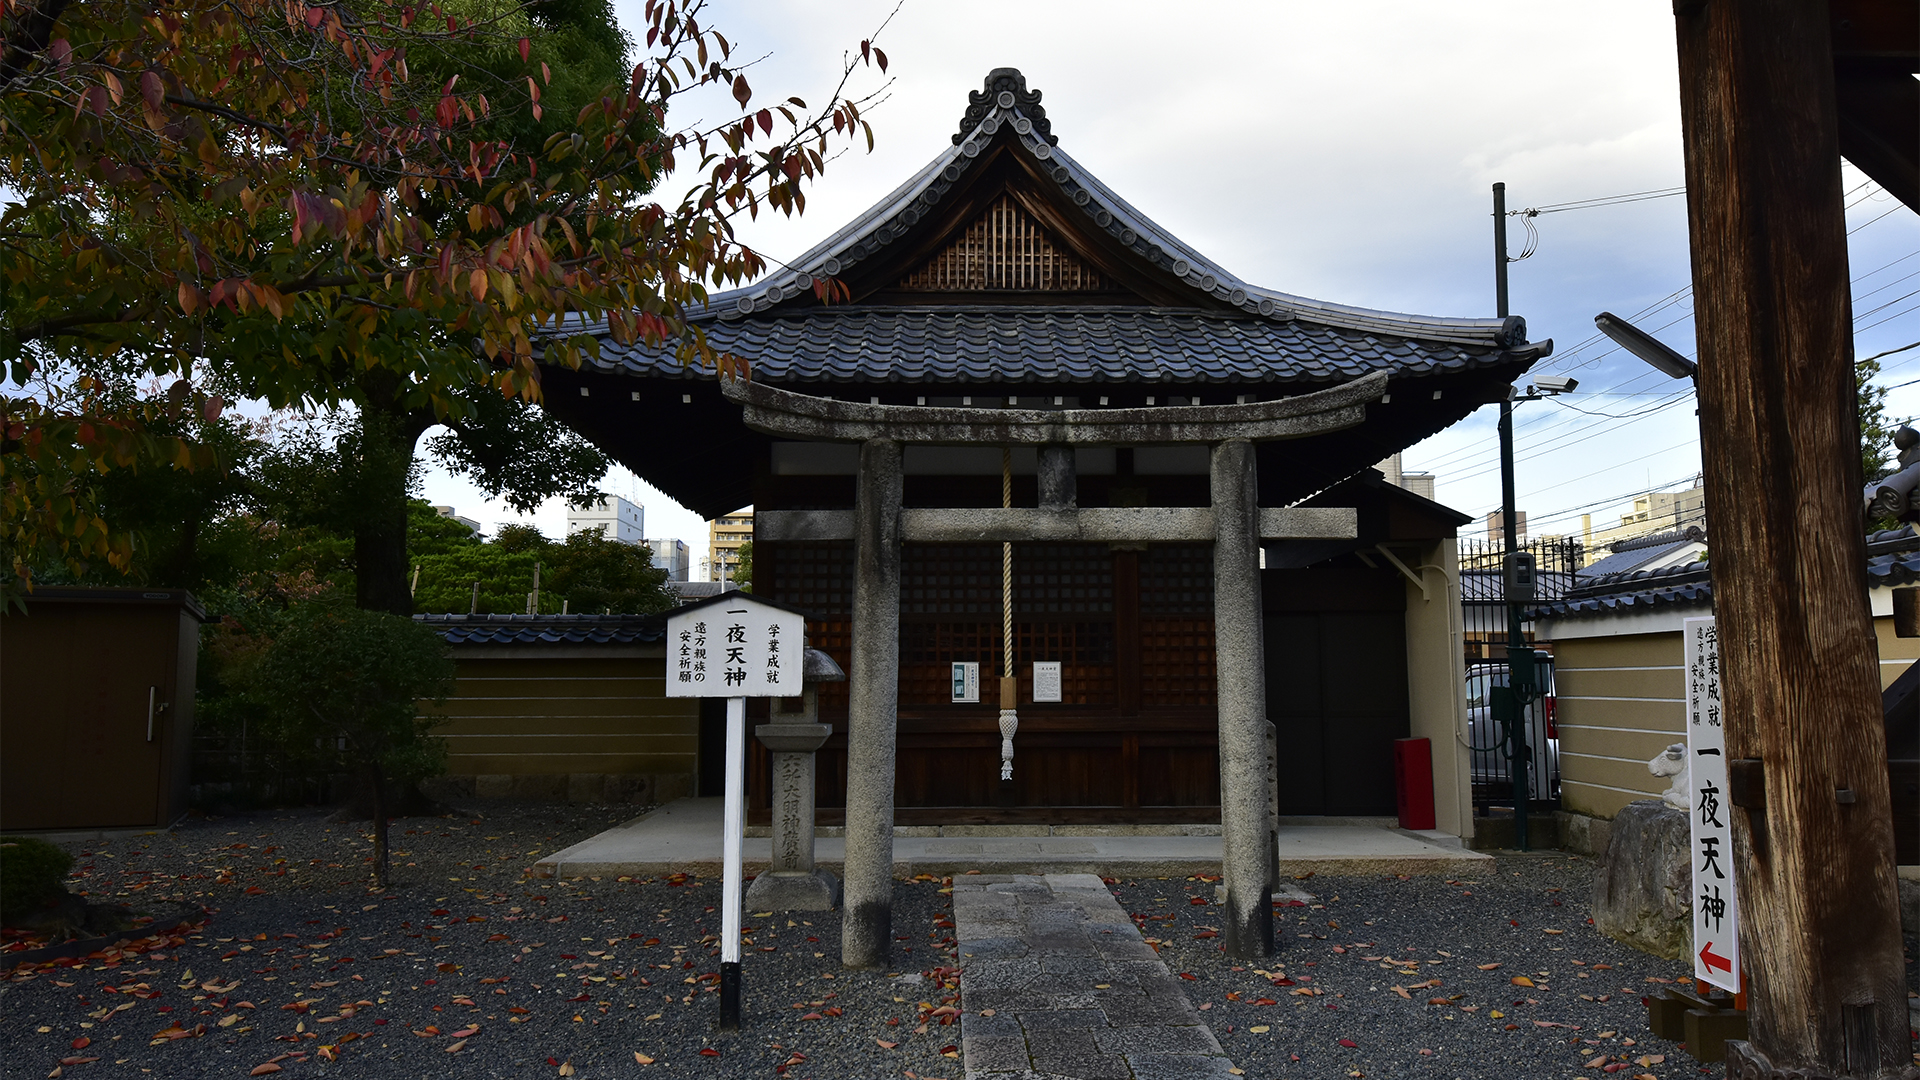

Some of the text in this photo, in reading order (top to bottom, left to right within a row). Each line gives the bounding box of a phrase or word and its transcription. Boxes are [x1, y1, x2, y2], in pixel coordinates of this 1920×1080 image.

[678, 630, 692, 683] 安全祈願
[693, 622, 707, 683] 遠方親族の
[724, 609, 748, 687] 一夜天神
[766, 624, 780, 684] 学業成就
[1697, 626, 1706, 693] 遠方親族の
[1705, 626, 1721, 727] 学業成就
[1691, 662, 1701, 726] 安全祈願
[1697, 748, 1726, 934] 一夜天神
